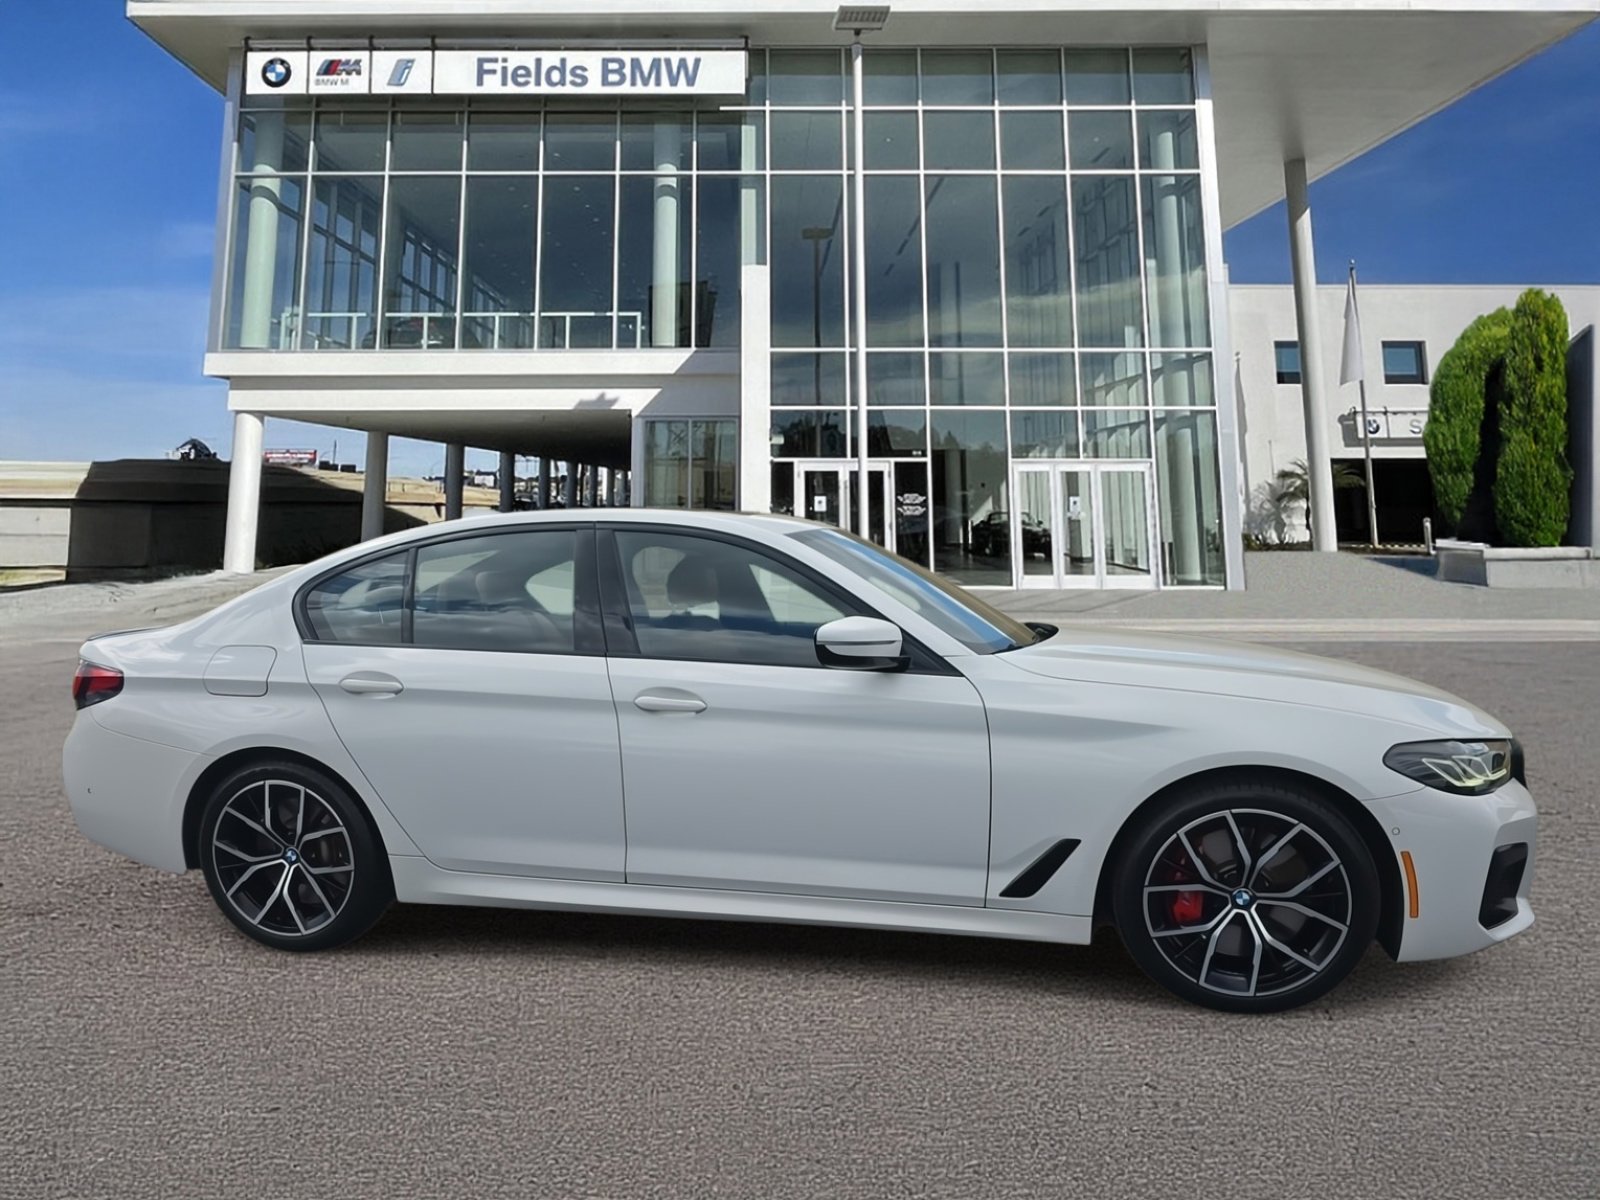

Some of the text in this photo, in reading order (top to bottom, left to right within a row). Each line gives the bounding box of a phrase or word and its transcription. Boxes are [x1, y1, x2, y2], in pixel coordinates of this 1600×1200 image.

[314, 78, 339, 86] BMW
[476, 57, 701, 88] Fields BMW
